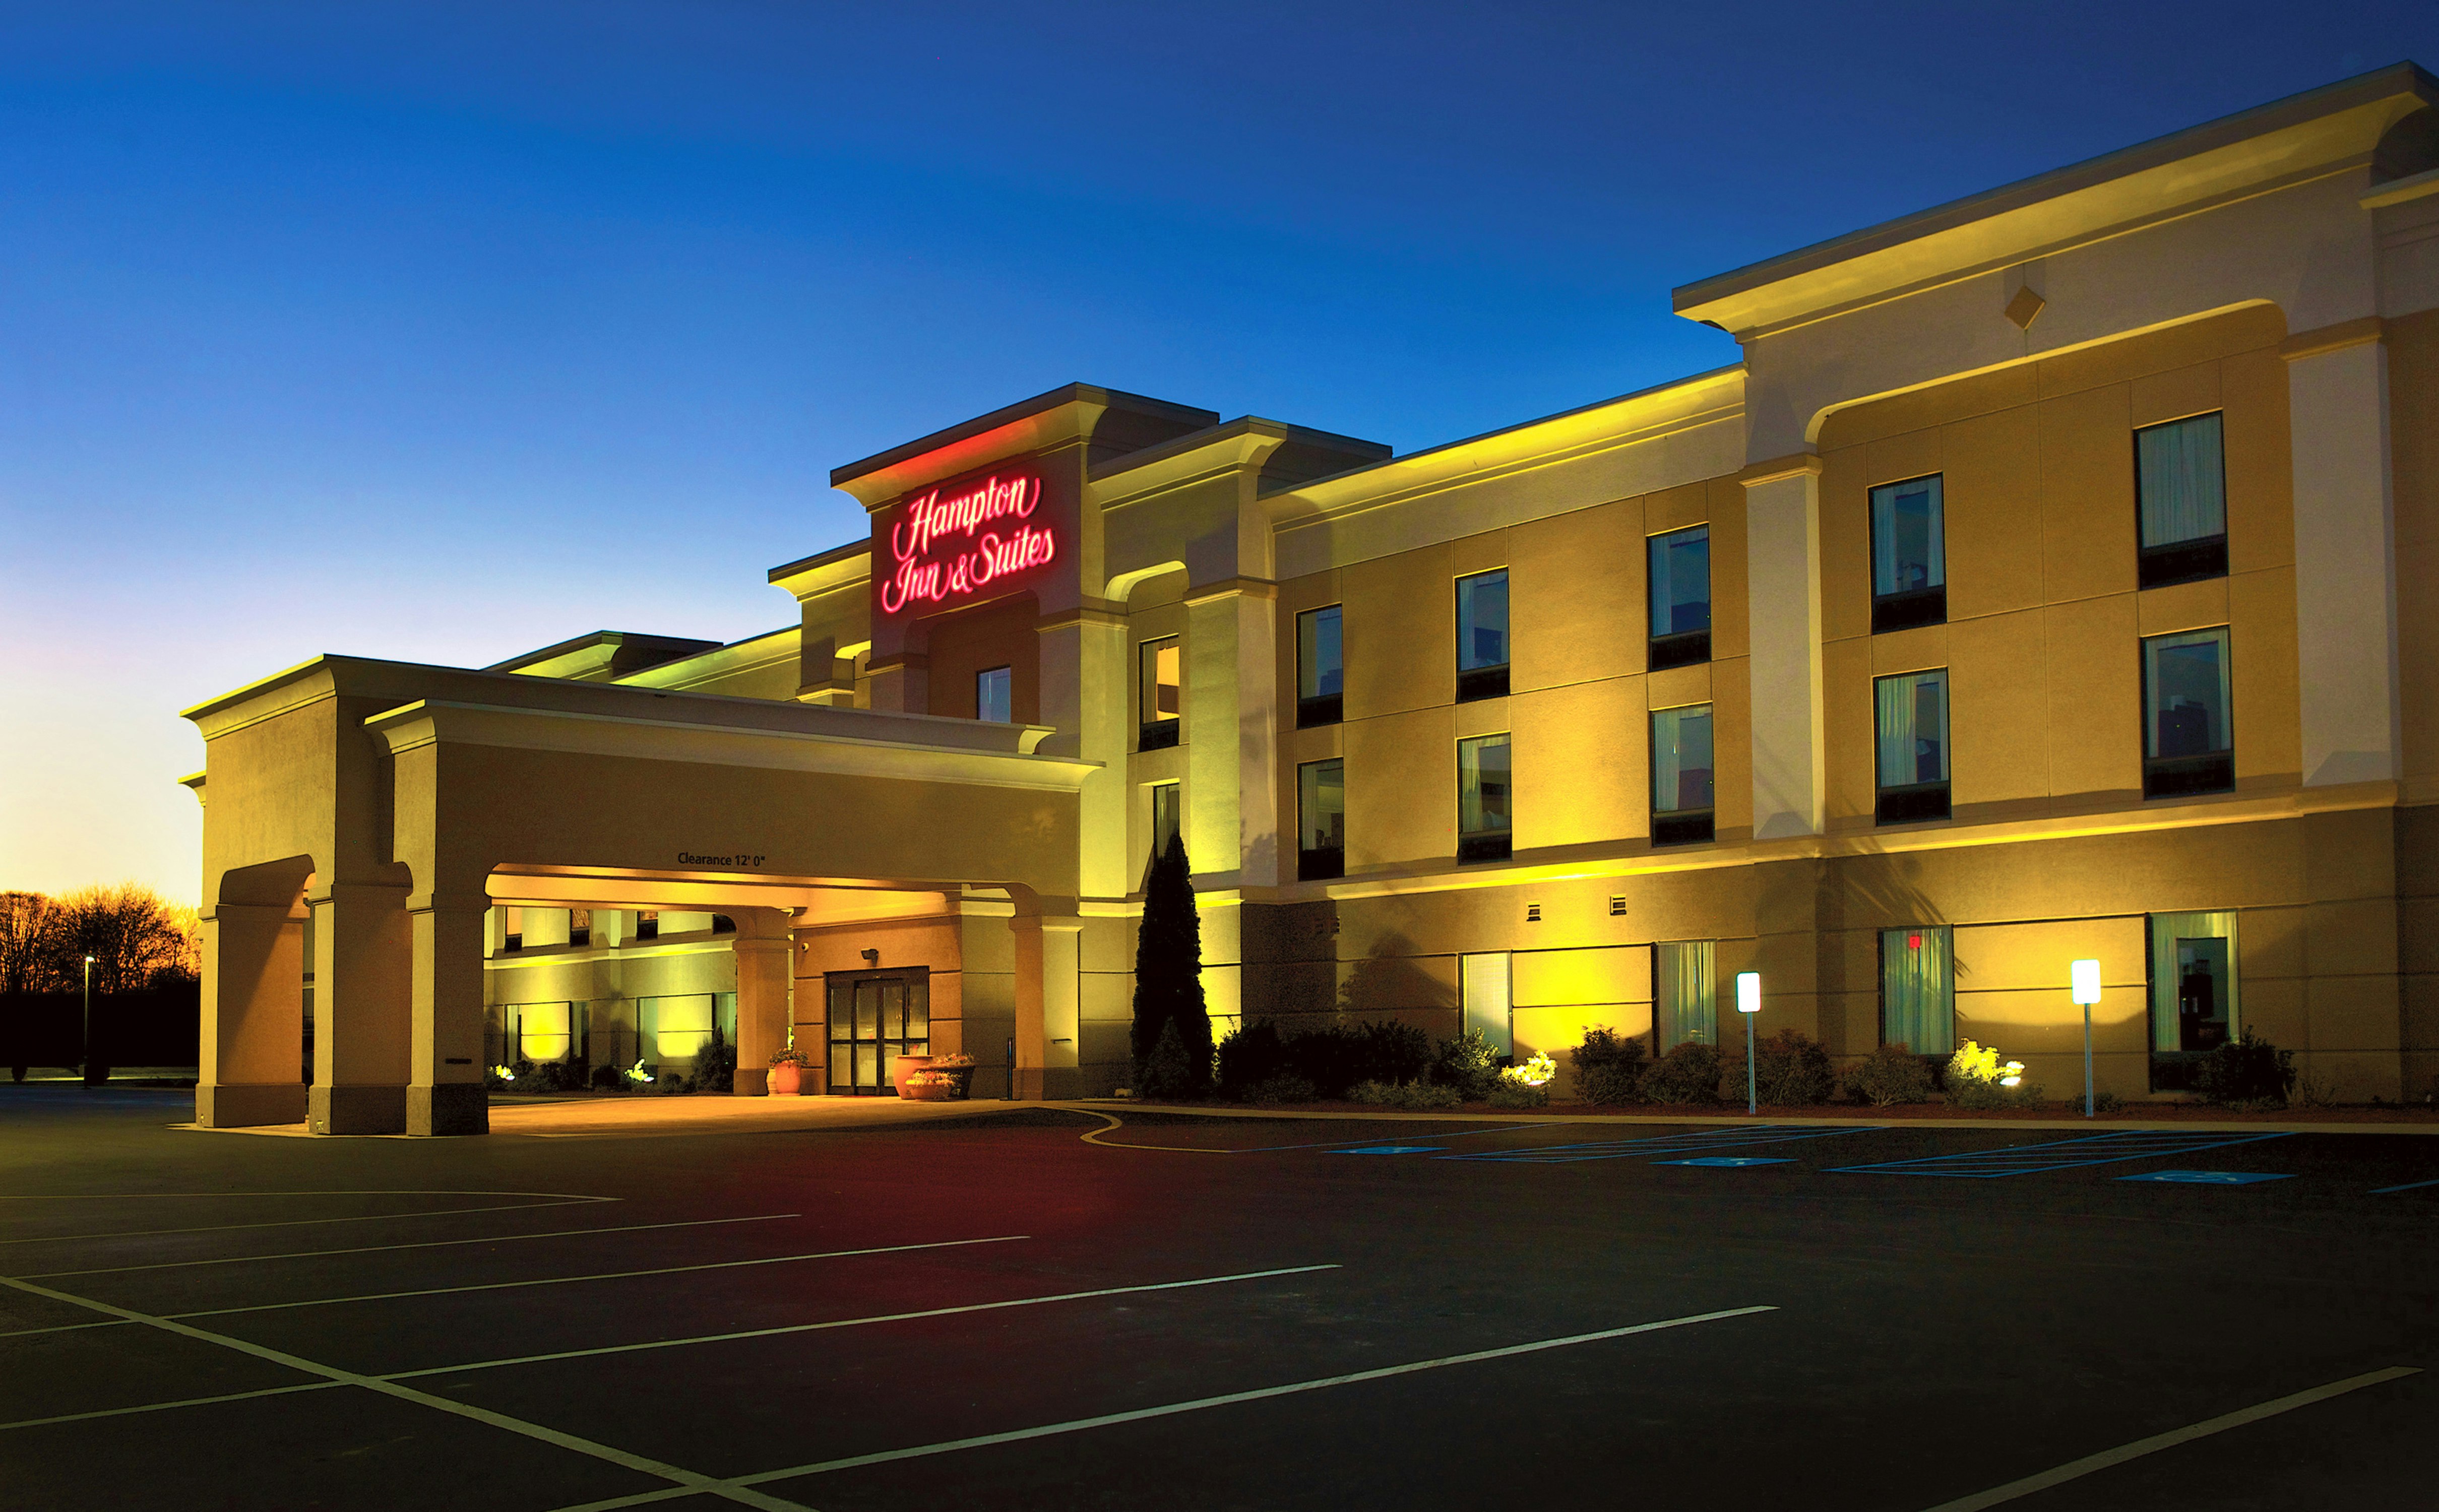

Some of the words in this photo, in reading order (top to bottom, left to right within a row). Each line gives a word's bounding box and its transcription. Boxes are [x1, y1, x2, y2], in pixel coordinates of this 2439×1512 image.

[893, 476, 1040, 562] Hampton
[882, 555, 953, 613] Inn
[951, 553, 973, 594] &
[969, 525, 1054, 586] Suites
[678, 852, 732, 865] Clearance
[735, 855, 750, 866] 12'
[754, 856, 765, 866] 0"
